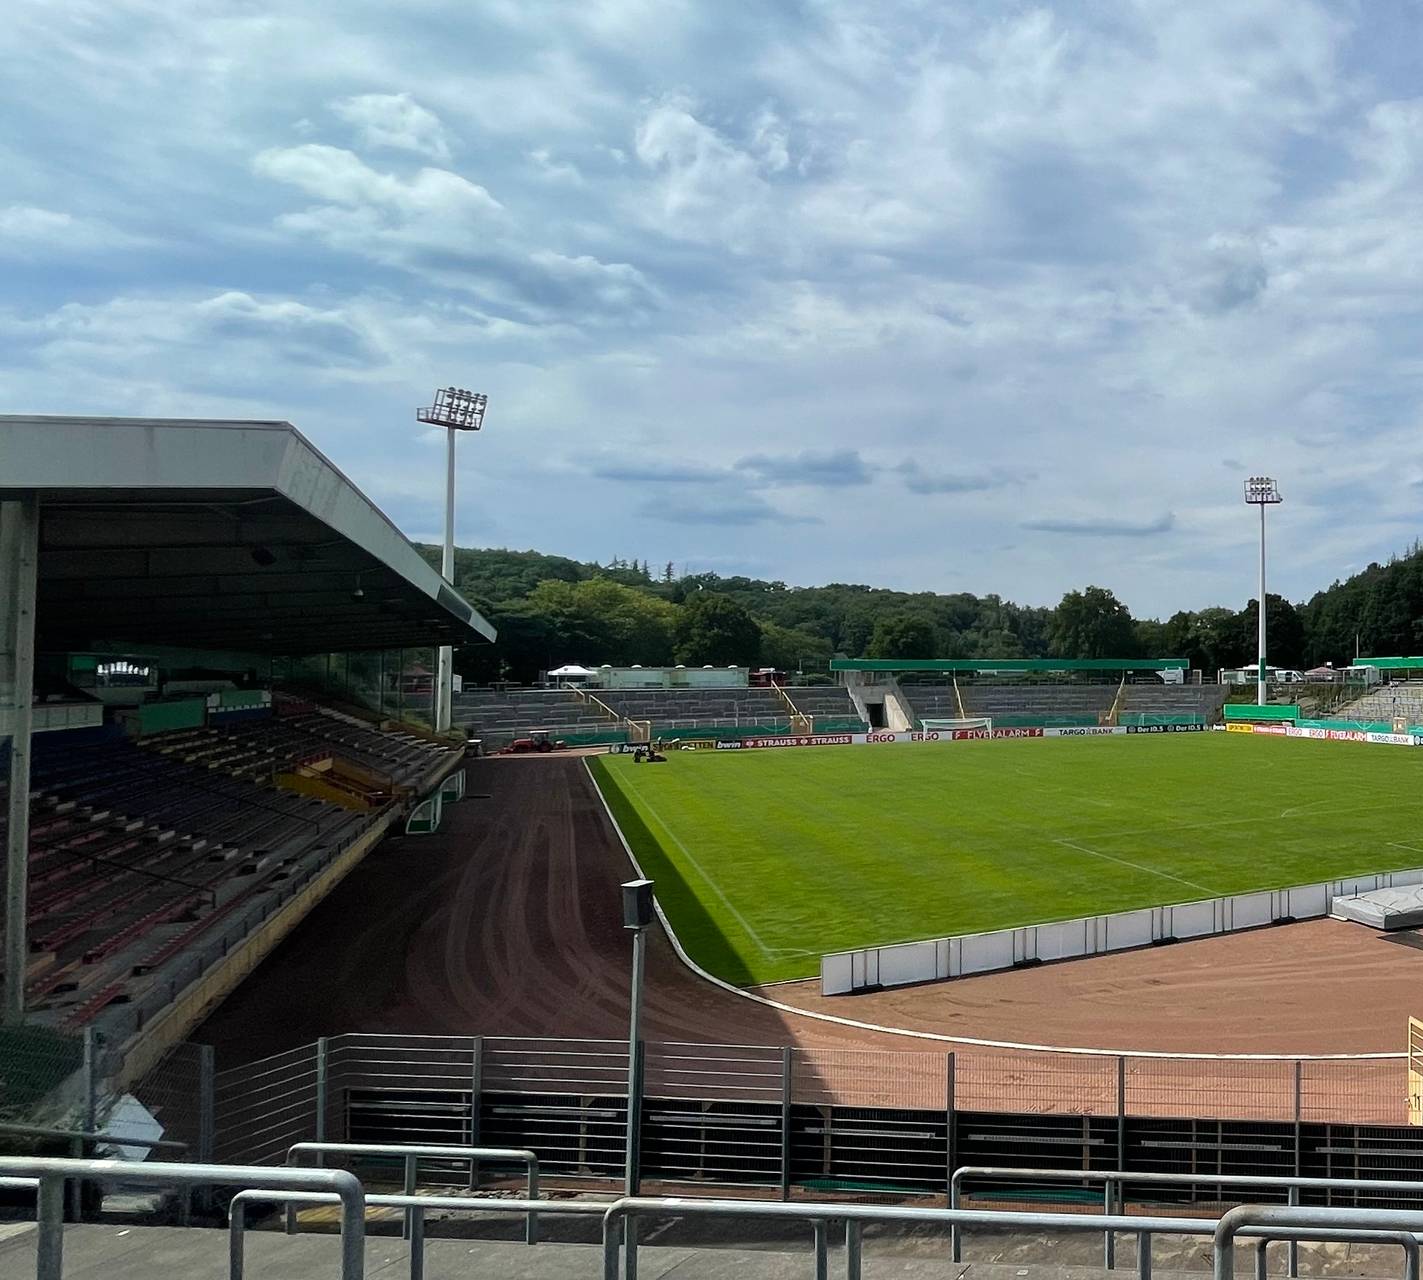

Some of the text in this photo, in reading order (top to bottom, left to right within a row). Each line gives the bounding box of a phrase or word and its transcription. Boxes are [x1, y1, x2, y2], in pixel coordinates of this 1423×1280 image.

[811, 736, 849, 746] STRAUSS
[866, 734, 896, 744] ERGO
[911, 732, 940, 742] ERGO
[717, 741, 741, 749] bwin
[757, 738, 797, 748] STRAUSS
